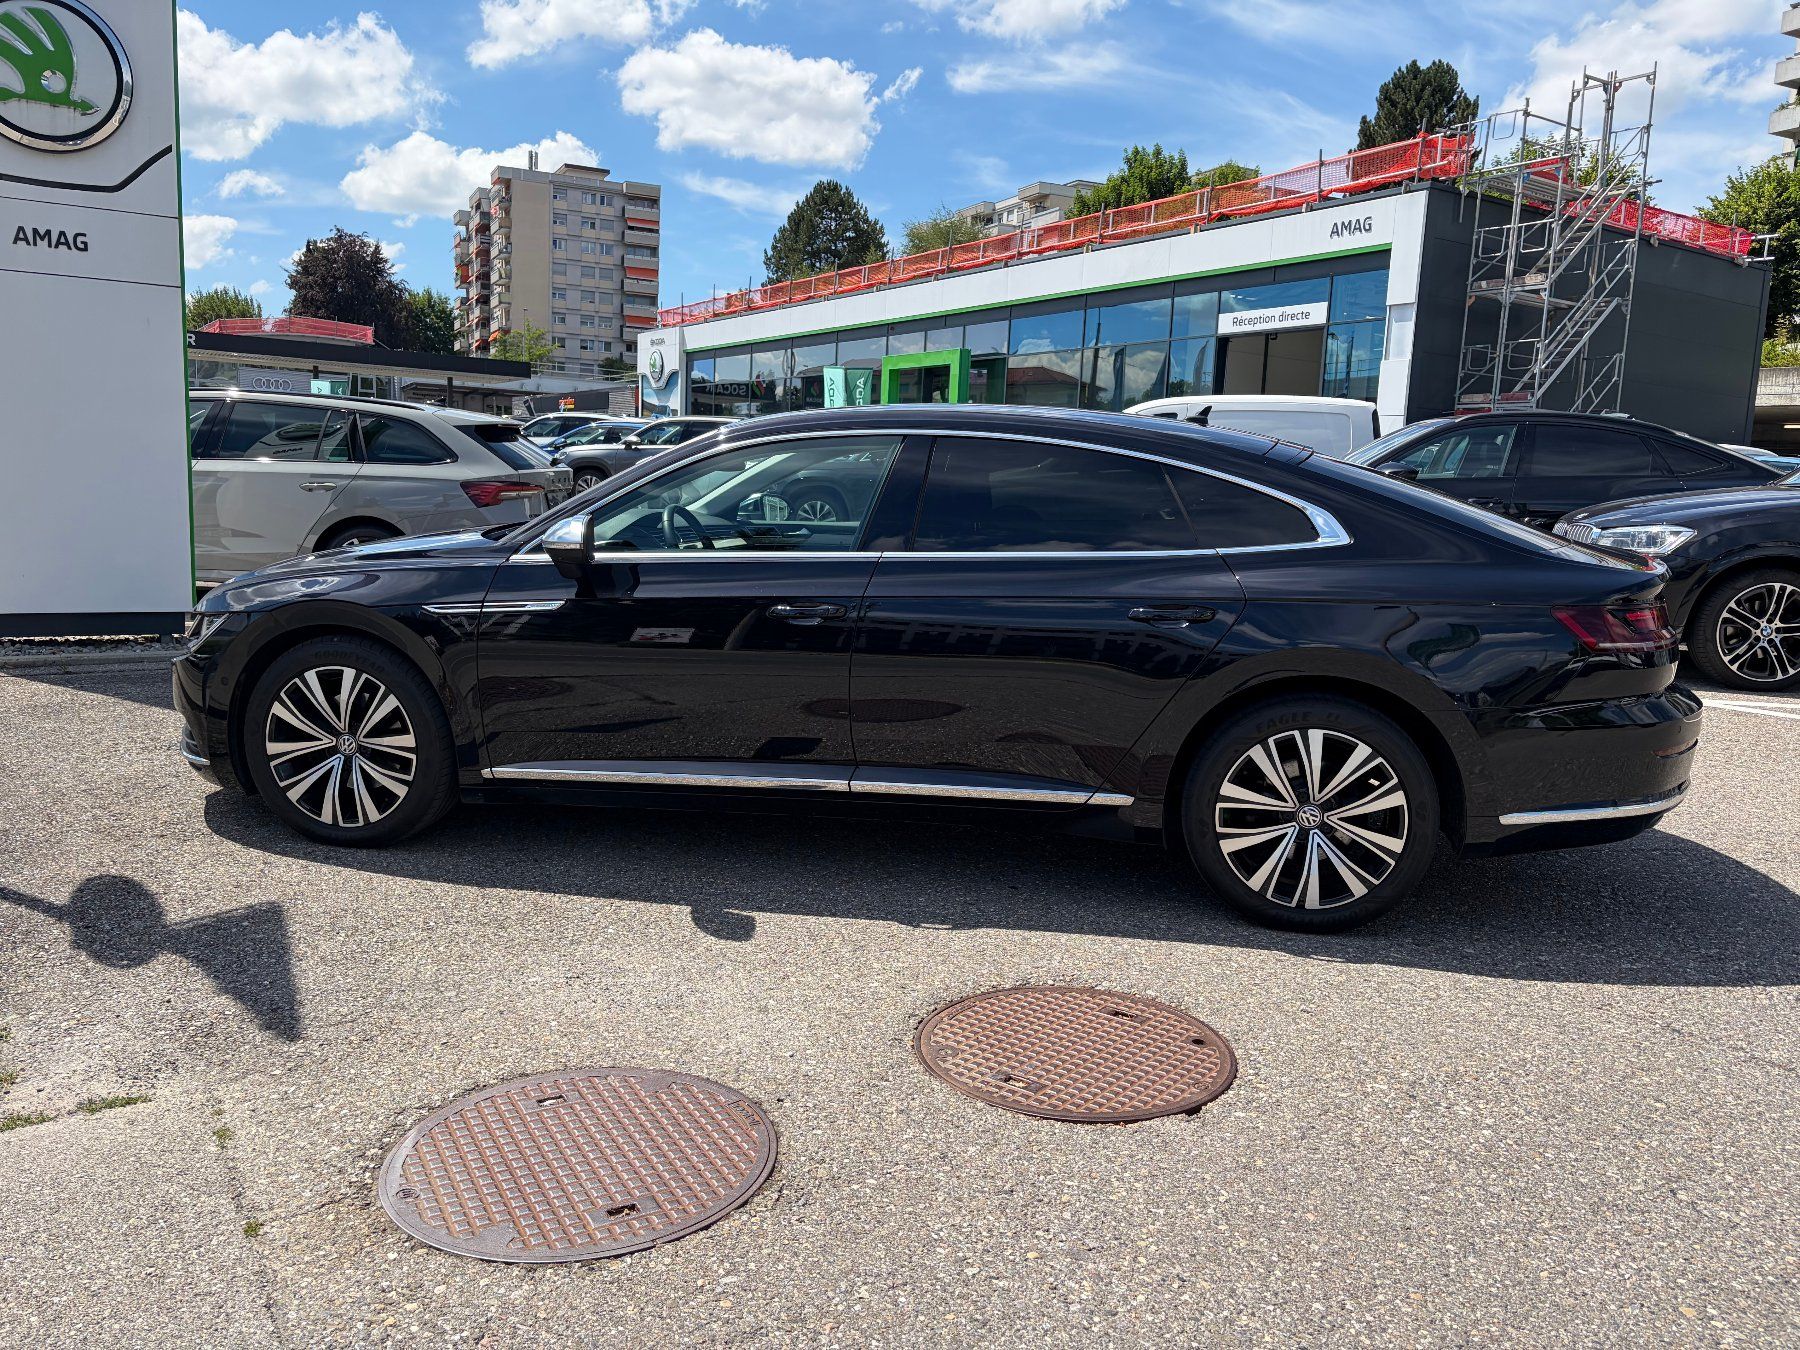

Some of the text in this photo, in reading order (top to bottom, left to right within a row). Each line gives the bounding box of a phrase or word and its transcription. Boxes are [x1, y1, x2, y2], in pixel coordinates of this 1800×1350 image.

[12, 225, 89, 252] AMAG
[1329, 216, 1373, 240] AMAG
[1232, 310, 1311, 328] Réception directe
